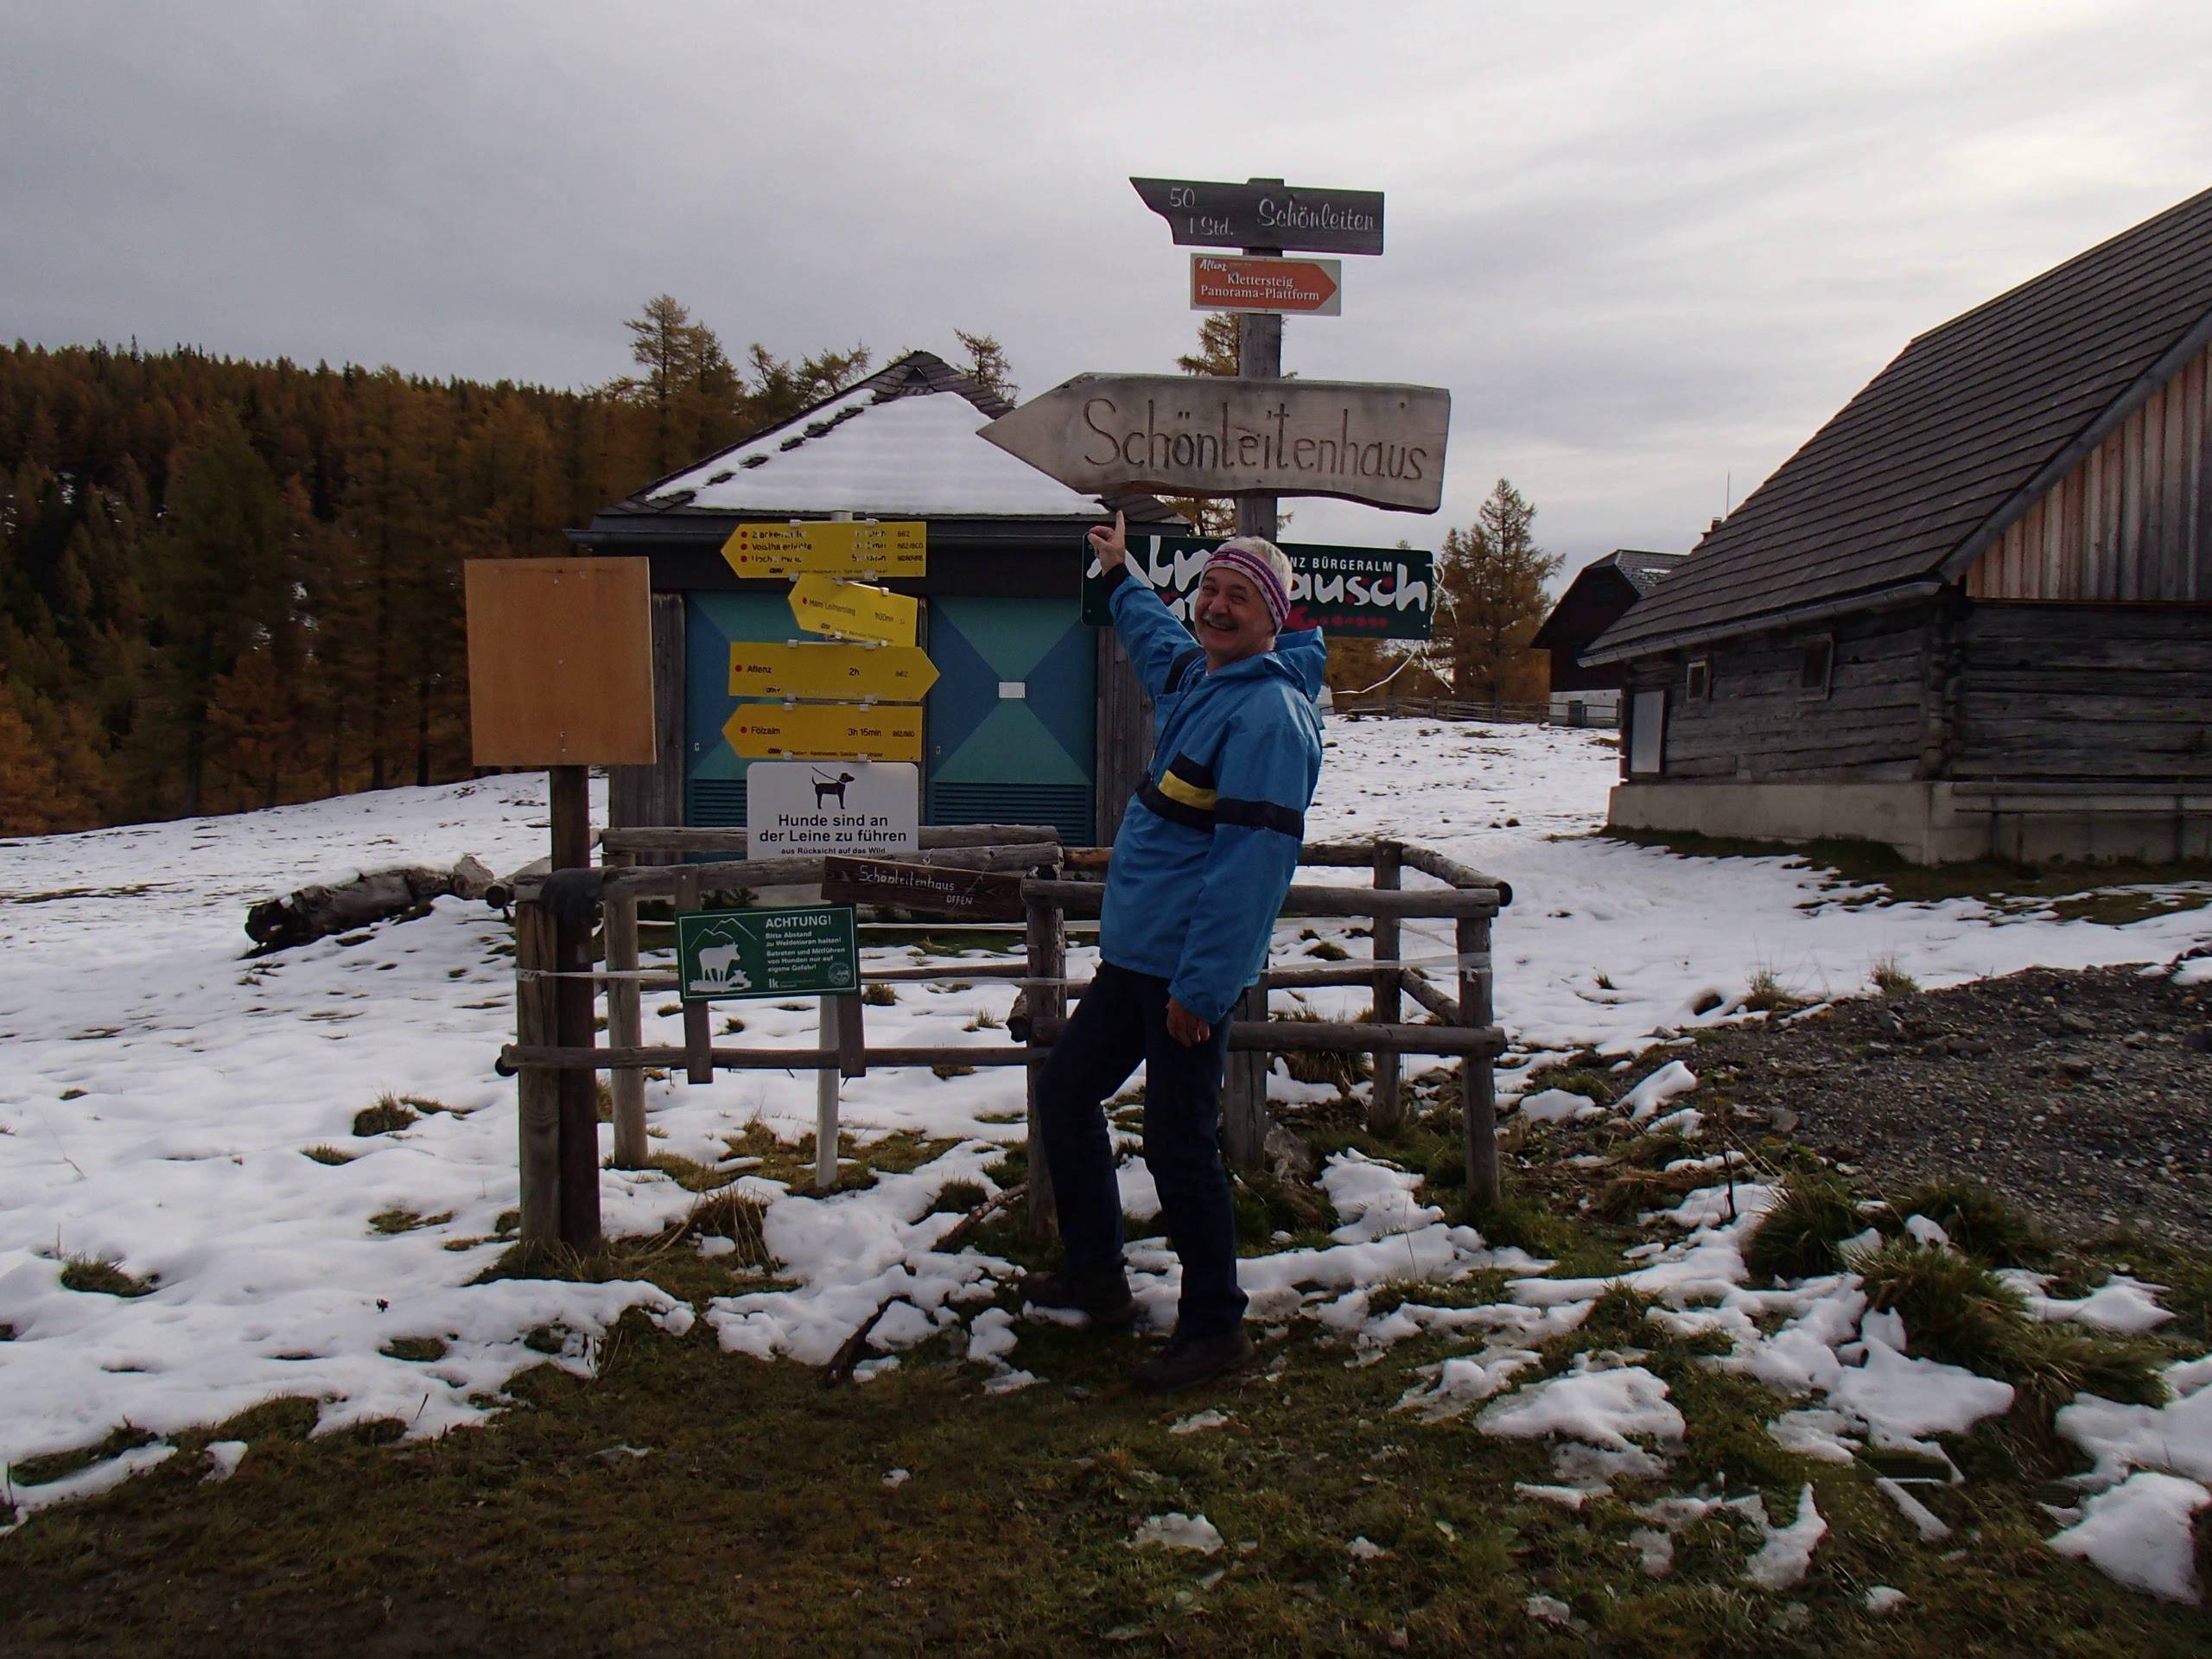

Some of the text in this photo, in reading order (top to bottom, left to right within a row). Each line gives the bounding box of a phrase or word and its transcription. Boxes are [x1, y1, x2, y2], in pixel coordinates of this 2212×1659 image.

[1169, 188, 1195, 208] 50
[1258, 195, 1374, 231] Schönleiten
[1201, 217, 1234, 236] Std.
[1228, 273, 1294, 289] Klettersteig
[1200, 284, 1320, 302] Panorama-Plattform
[1083, 397, 1427, 482] Schönleitenhaus
[1313, 556, 1393, 572] BÜRGERALM
[1287, 563, 1427, 612] ausch
[849, 668, 860, 677] 2h
[848, 728, 858, 737] 3h
[860, 728, 882, 737] 15min
[779, 814, 888, 827] Hunde sind an
[760, 830, 907, 842] der Leine zu führen
[859, 865, 955, 891] Schönleitenhaus
[946, 895, 974, 906] OFFEN
[766, 915, 831, 928] ACHTUNG!
